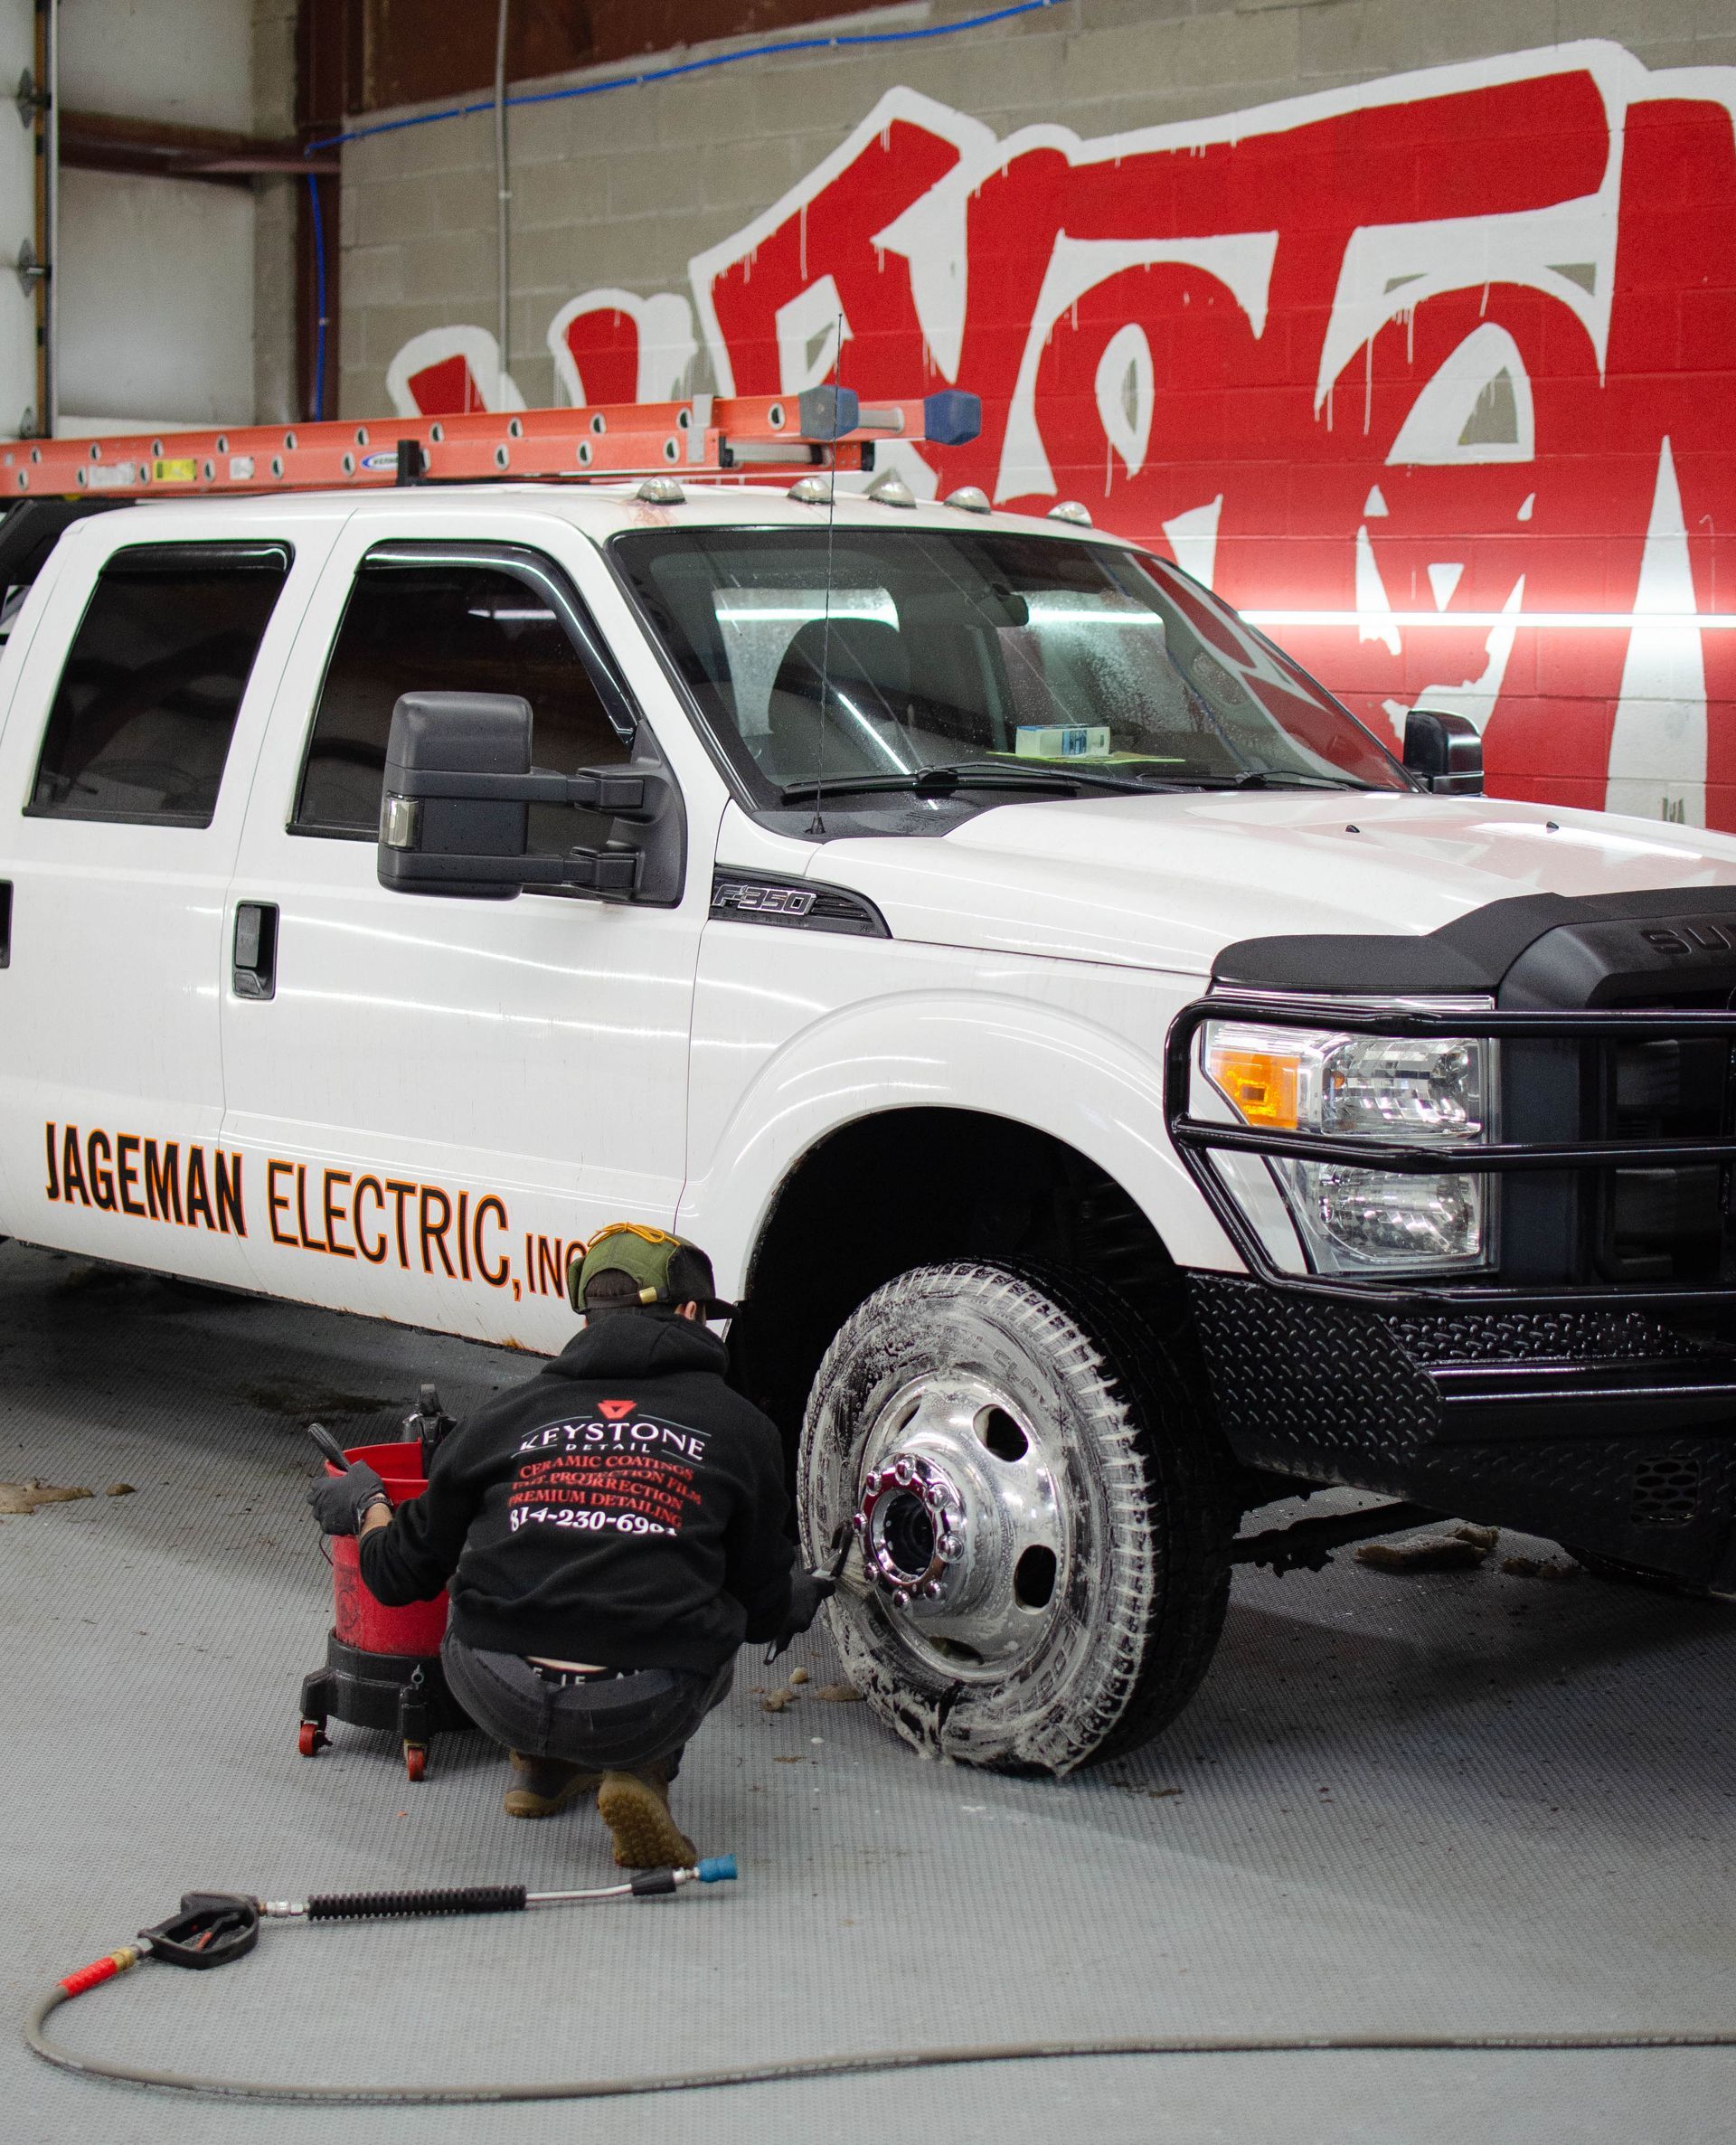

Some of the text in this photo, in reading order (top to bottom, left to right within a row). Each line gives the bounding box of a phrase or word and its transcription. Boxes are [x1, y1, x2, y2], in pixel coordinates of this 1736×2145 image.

[1640, 924, 1736, 955] SU
[45, 1122, 249, 1237] JAGEMAN
[268, 1158, 522, 1302] ELECTRIC,
[520, 1422, 706, 1460] KEYSTONE
[565, 1442, 651, 1453] DETAIL
[520, 1456, 694, 1481] CERAMIC COATINGS
[508, 1489, 684, 1527] PREMIUM DETAILING
